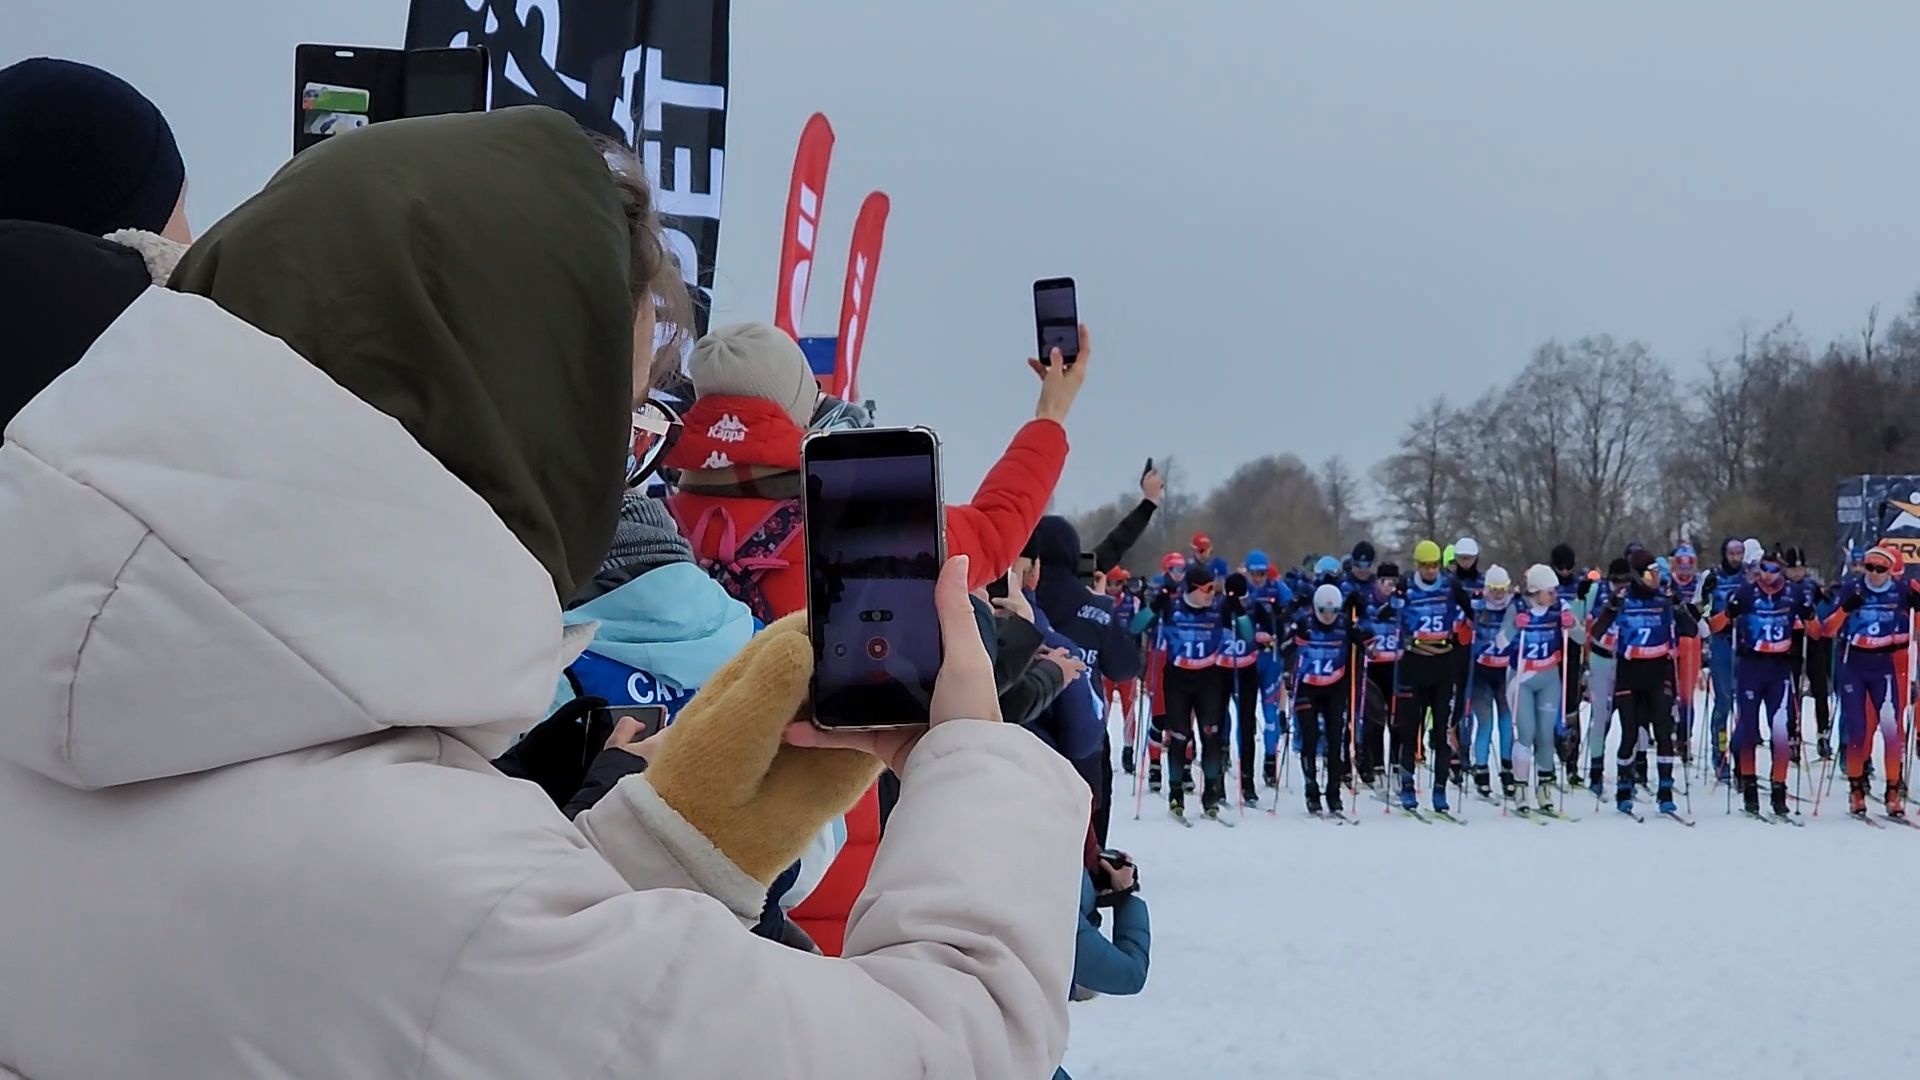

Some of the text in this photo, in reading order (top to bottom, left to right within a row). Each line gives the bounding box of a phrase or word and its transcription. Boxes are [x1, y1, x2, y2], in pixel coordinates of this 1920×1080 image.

[707, 427, 745, 442] Kappa
[1420, 615, 1443, 632] 25
[1638, 628, 1651, 645] 7
[1762, 624, 1784, 641] 13
[1183, 642, 1205, 657] 11
[1224, 639, 1246, 655] 20
[1375, 635, 1397, 650] 28
[1527, 642, 1549, 659] 21
[1312, 659, 1334, 674] 14
